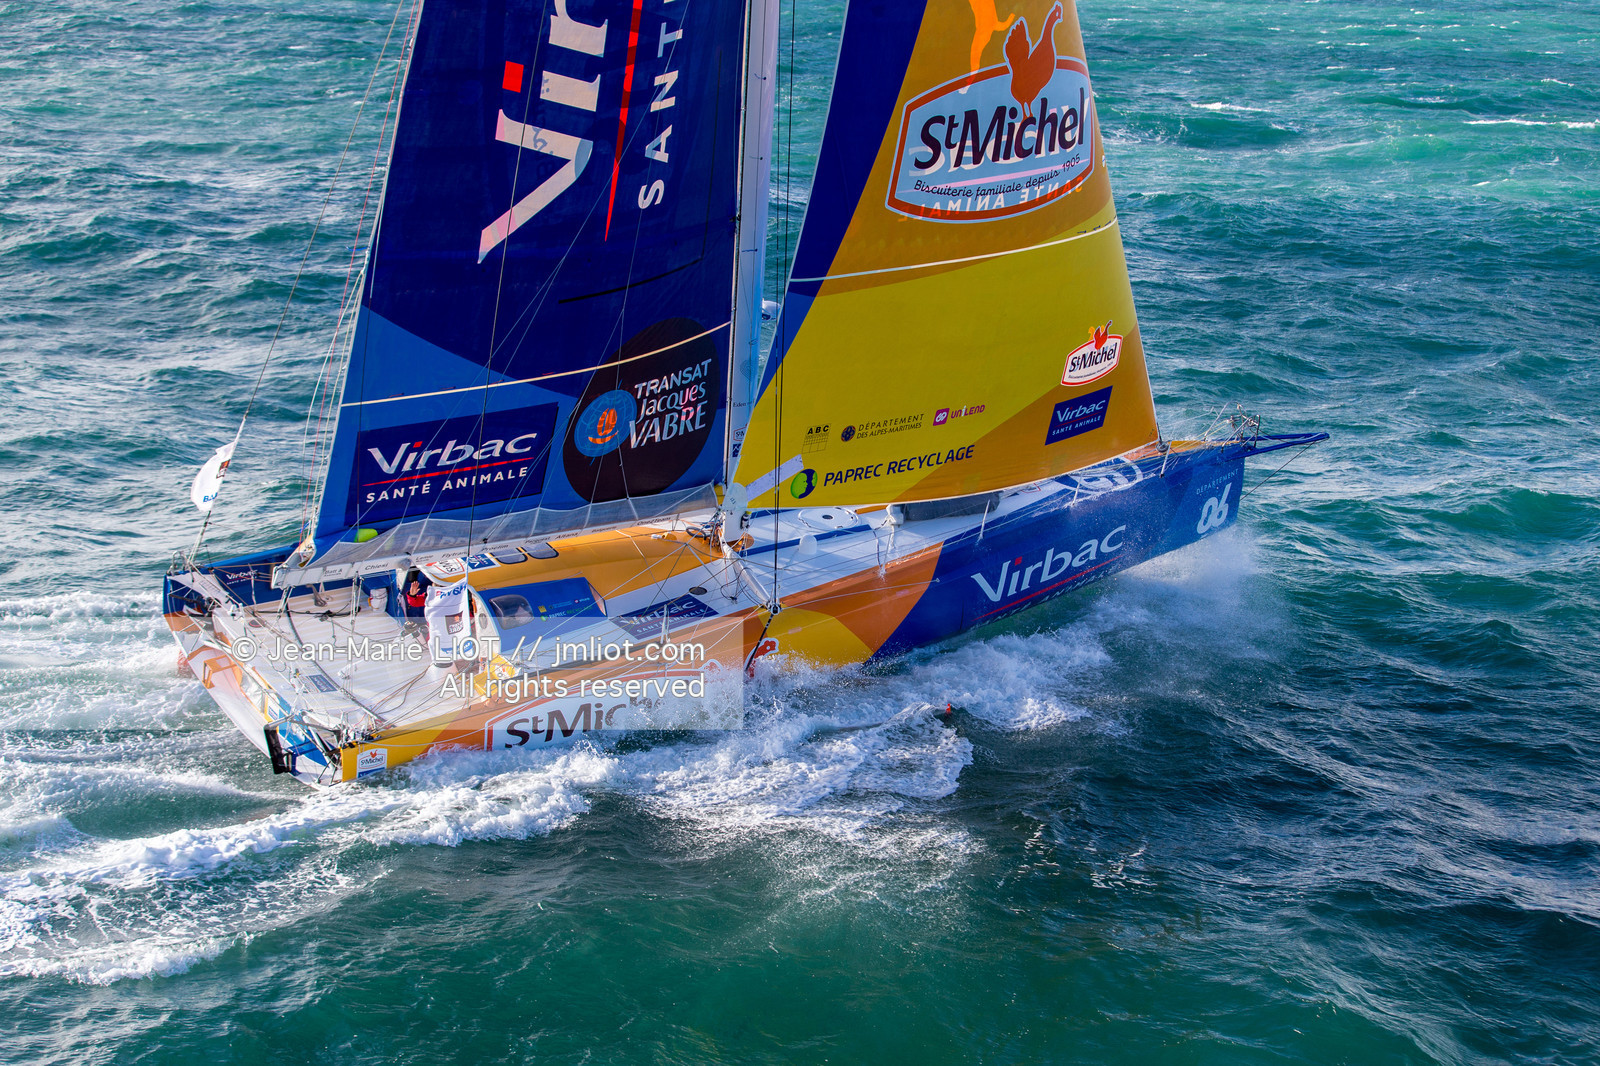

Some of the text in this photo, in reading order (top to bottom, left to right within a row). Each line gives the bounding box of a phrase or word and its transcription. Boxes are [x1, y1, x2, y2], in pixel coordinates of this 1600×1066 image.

[638, 0, 687, 209] SANT
[914, 153, 1081, 200] Biscuiterie familiale depuis 1905
[634, 358, 712, 399] TRANSAT
[629, 400, 708, 448] VABRE
[636, 381, 706, 424] Jacques
[1056, 400, 1106, 422] Virbac
[1074, 415, 1101, 429] ANIMALE
[856, 422, 922, 439] DES ALPES-MARITIMES
[367, 433, 537, 474] Virbac
[823, 444, 975, 487] PAPREC RECYCLAGE
[366, 467, 529, 503] SANTÉ ANIMALE
[1196, 482, 1232, 535] 06
[971, 525, 1126, 602] Virbac
